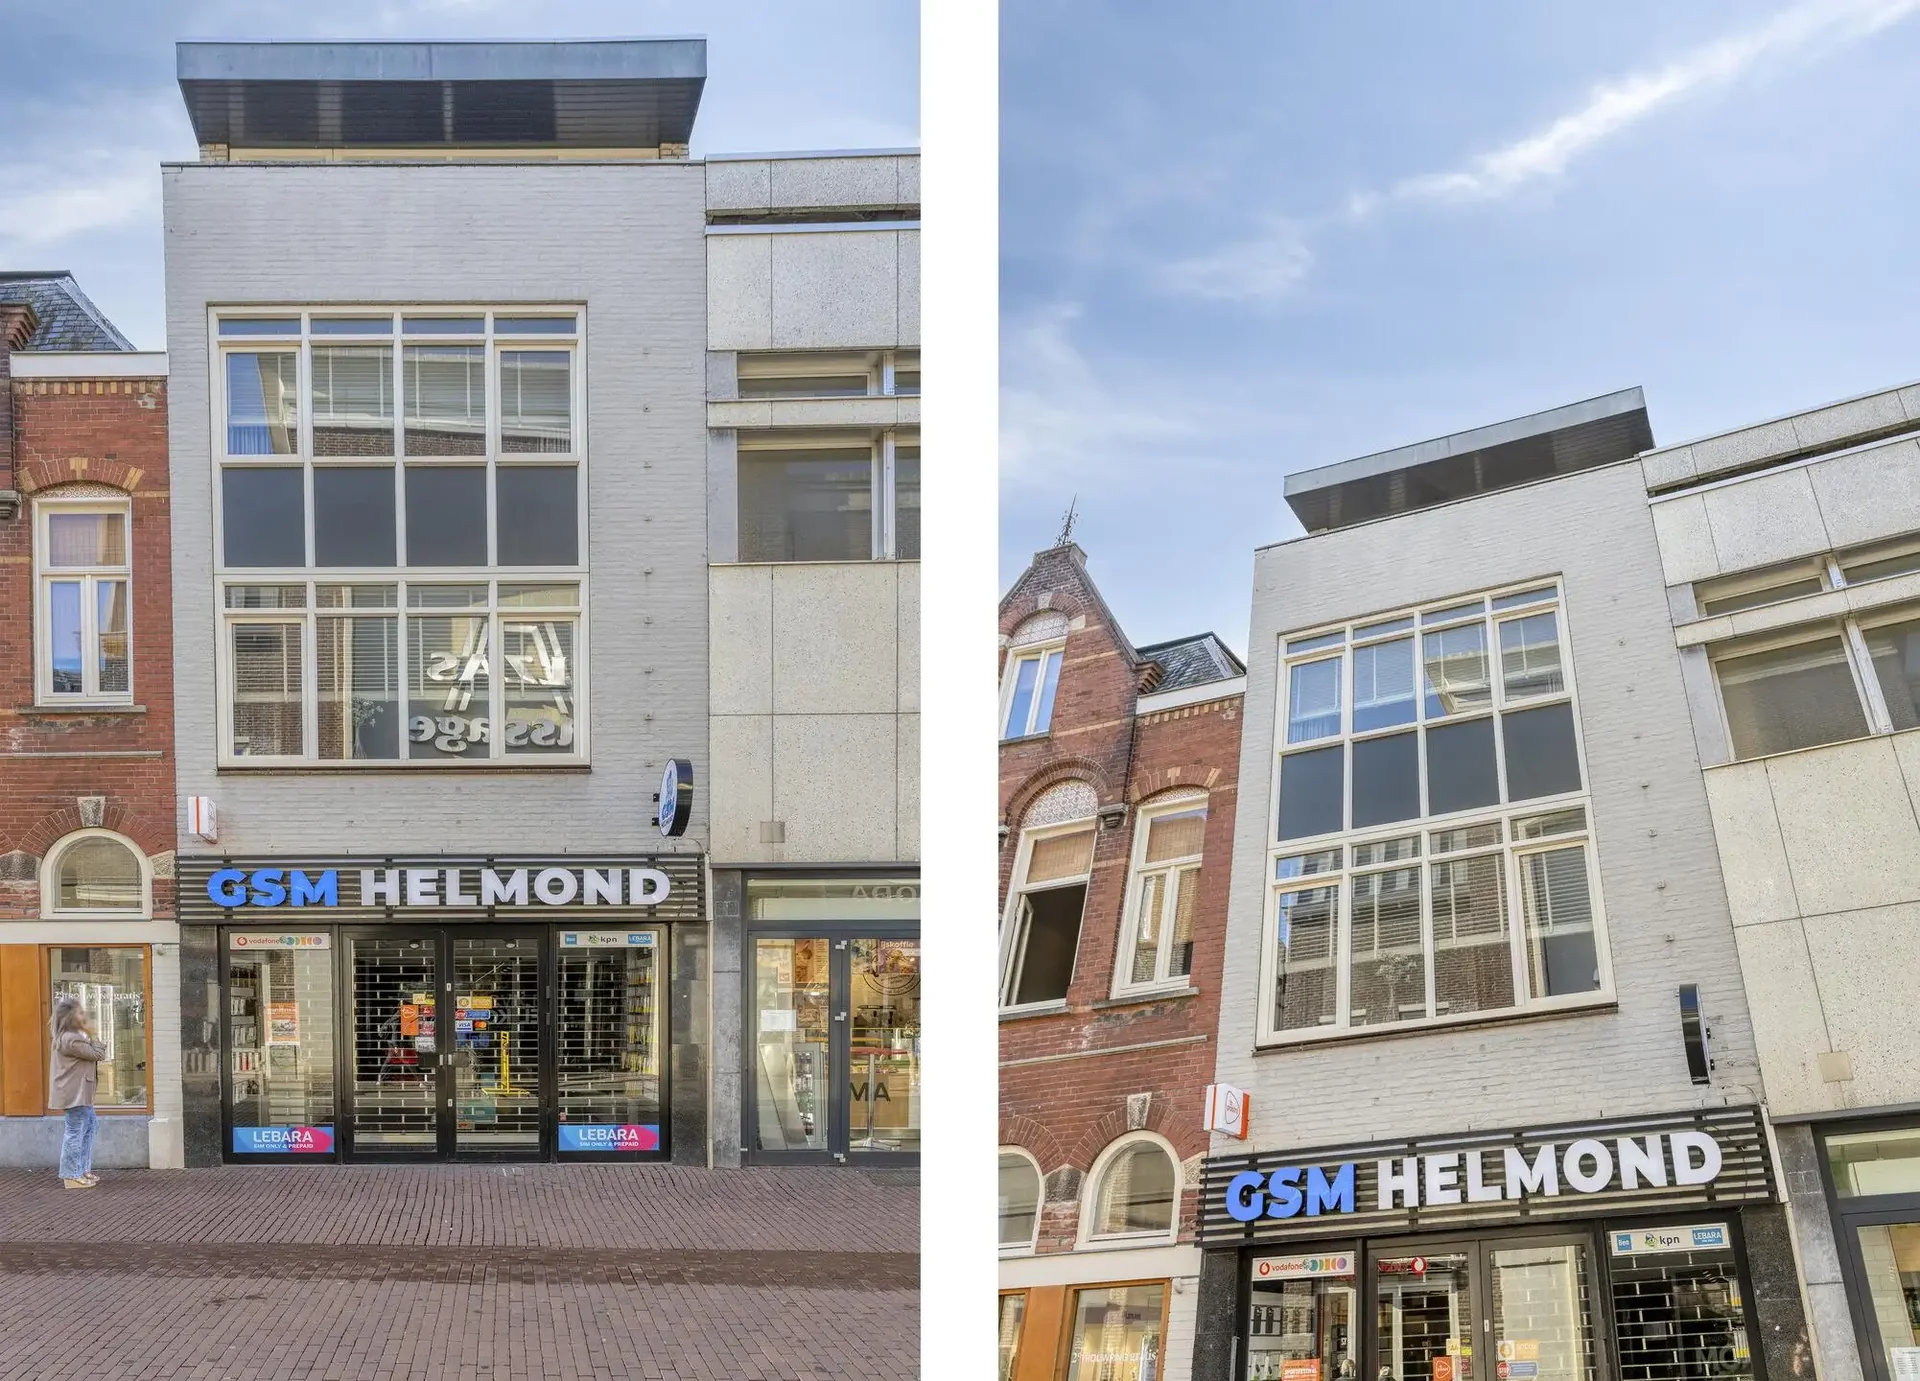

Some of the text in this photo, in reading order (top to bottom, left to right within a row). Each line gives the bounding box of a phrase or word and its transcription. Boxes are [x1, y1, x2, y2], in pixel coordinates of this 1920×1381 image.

[207, 868, 671, 907] GSM HELMOND
[249, 937, 280, 945] vodafone
[600, 936, 618, 944] kpn
[253, 1131, 313, 1143] LEBARA
[579, 1129, 639, 1141] LEBARA
[1226, 1131, 1723, 1222] GSM HELMOND
[1660, 1235, 1680, 1246] kpn
[1693, 1231, 1721, 1240] LEBARA
[1272, 1263, 1303, 1272] vodafone
